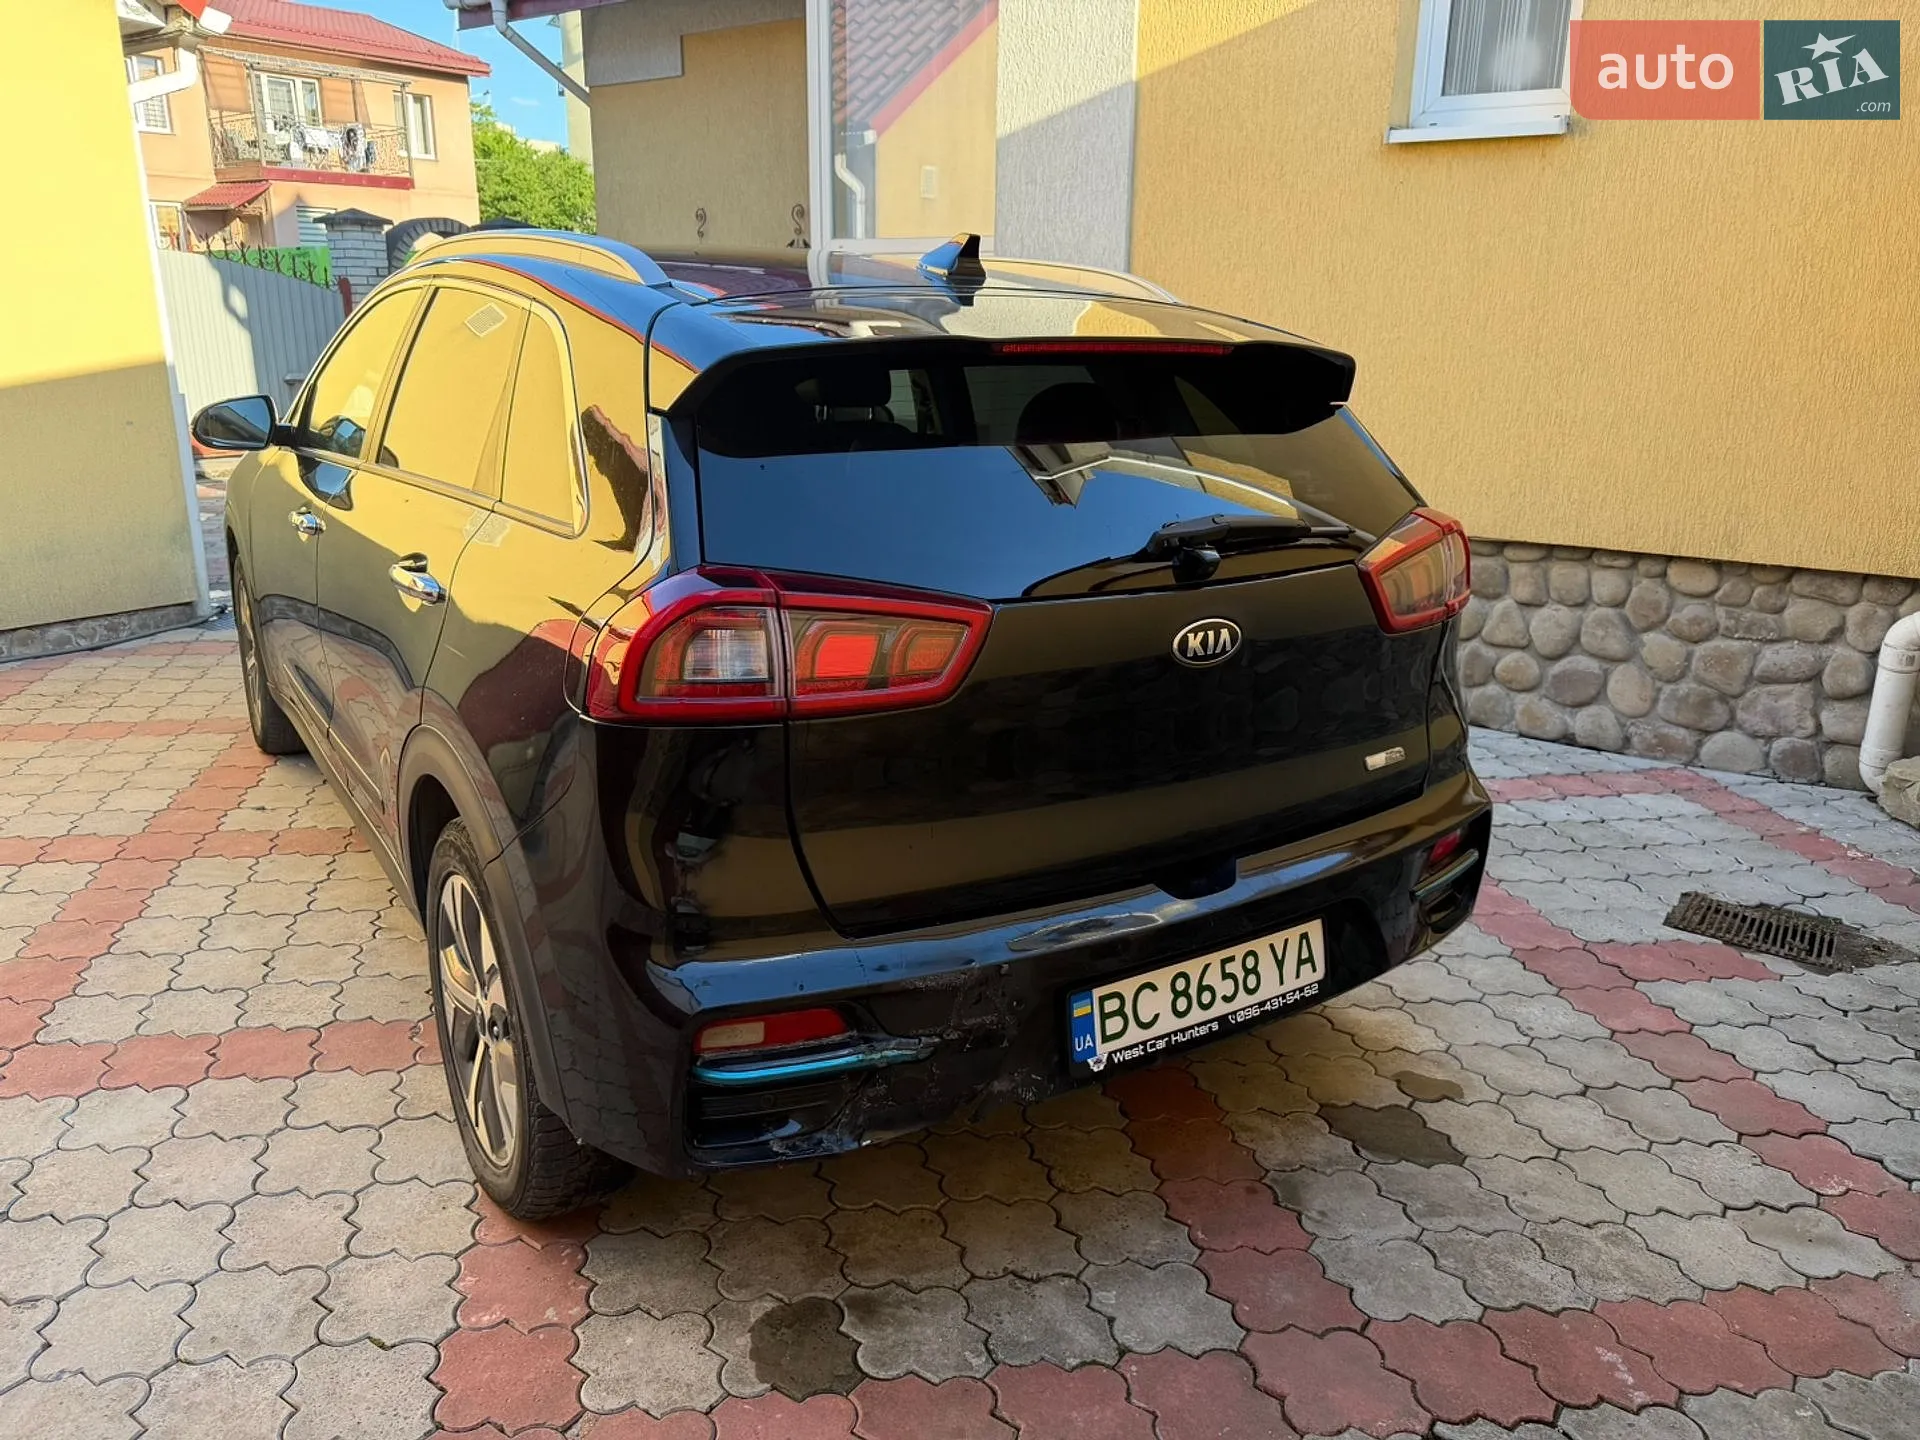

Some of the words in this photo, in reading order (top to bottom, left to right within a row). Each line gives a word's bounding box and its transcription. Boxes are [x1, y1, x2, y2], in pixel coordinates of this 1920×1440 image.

[1187, 628, 1232, 657] KIA
[1098, 981, 1159, 1044] BC
[1170, 950, 1261, 1019] 8658
[1269, 932, 1317, 986] YA
[1074, 1034, 1094, 1051] UA
[1112, 1045, 1145, 1064] West
[1146, 1037, 1168, 1052] Car
[1170, 1021, 1219, 1045] Hunters
